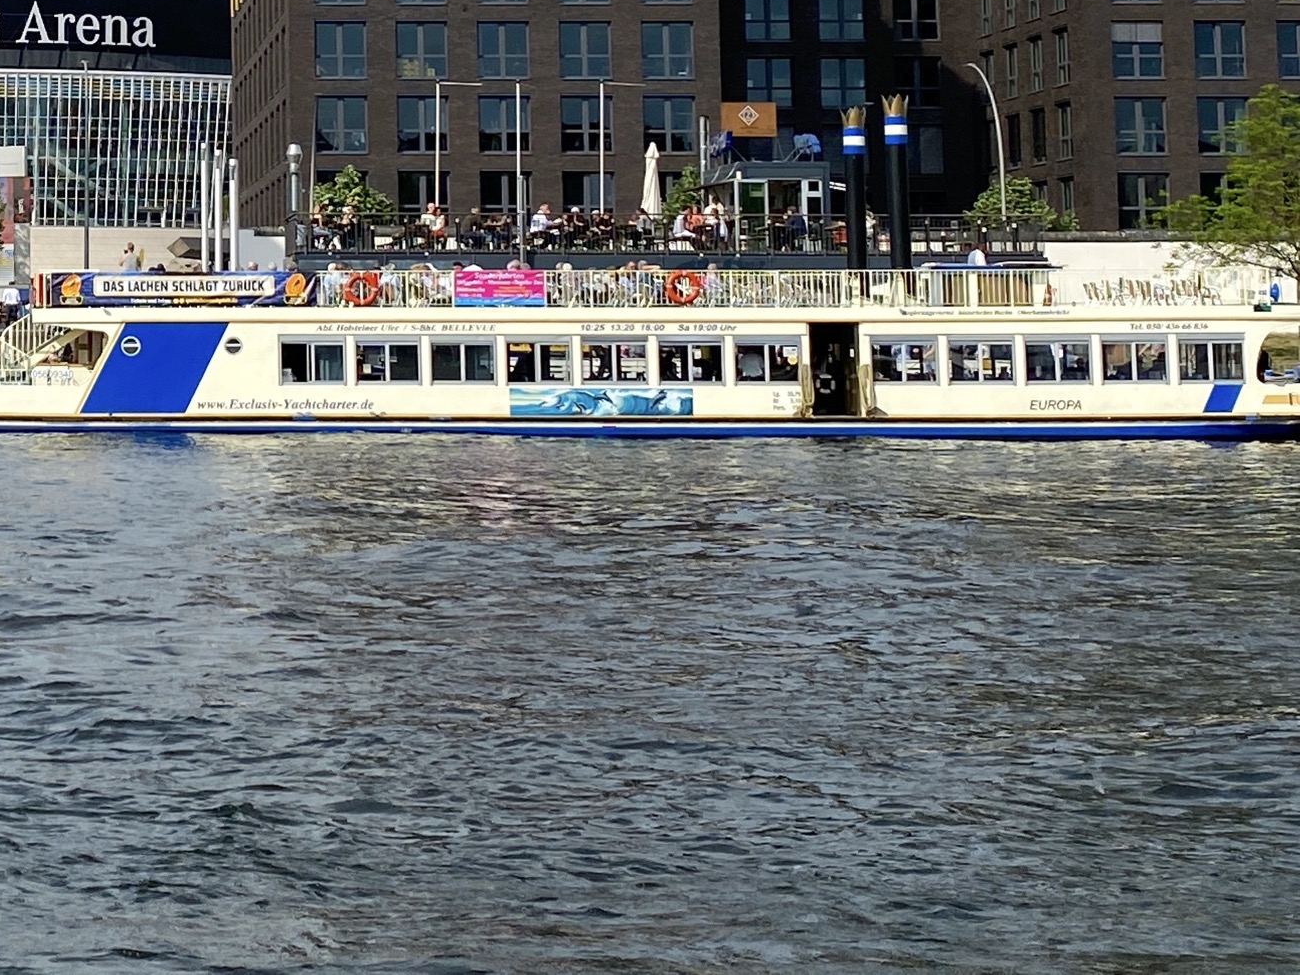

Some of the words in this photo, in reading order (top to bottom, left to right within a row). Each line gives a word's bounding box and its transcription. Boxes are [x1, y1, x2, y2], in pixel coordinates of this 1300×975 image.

[16, 0, 156, 48] Arena
[103, 280, 124, 292] DAS
[128, 280, 168, 292] LACHEN
[441, 324, 497, 332] BELLEVUE
[580, 324, 605, 332] 10:25
[610, 324, 635, 332] 13:20
[677, 324, 690, 332] Sa
[692, 324, 718, 332] 19:00
[720, 324, 738, 332] Uhr
[197, 398, 375, 411] www.Exclusiv-Yachtcharter.de
[1029, 399, 1082, 411] EUROPA
